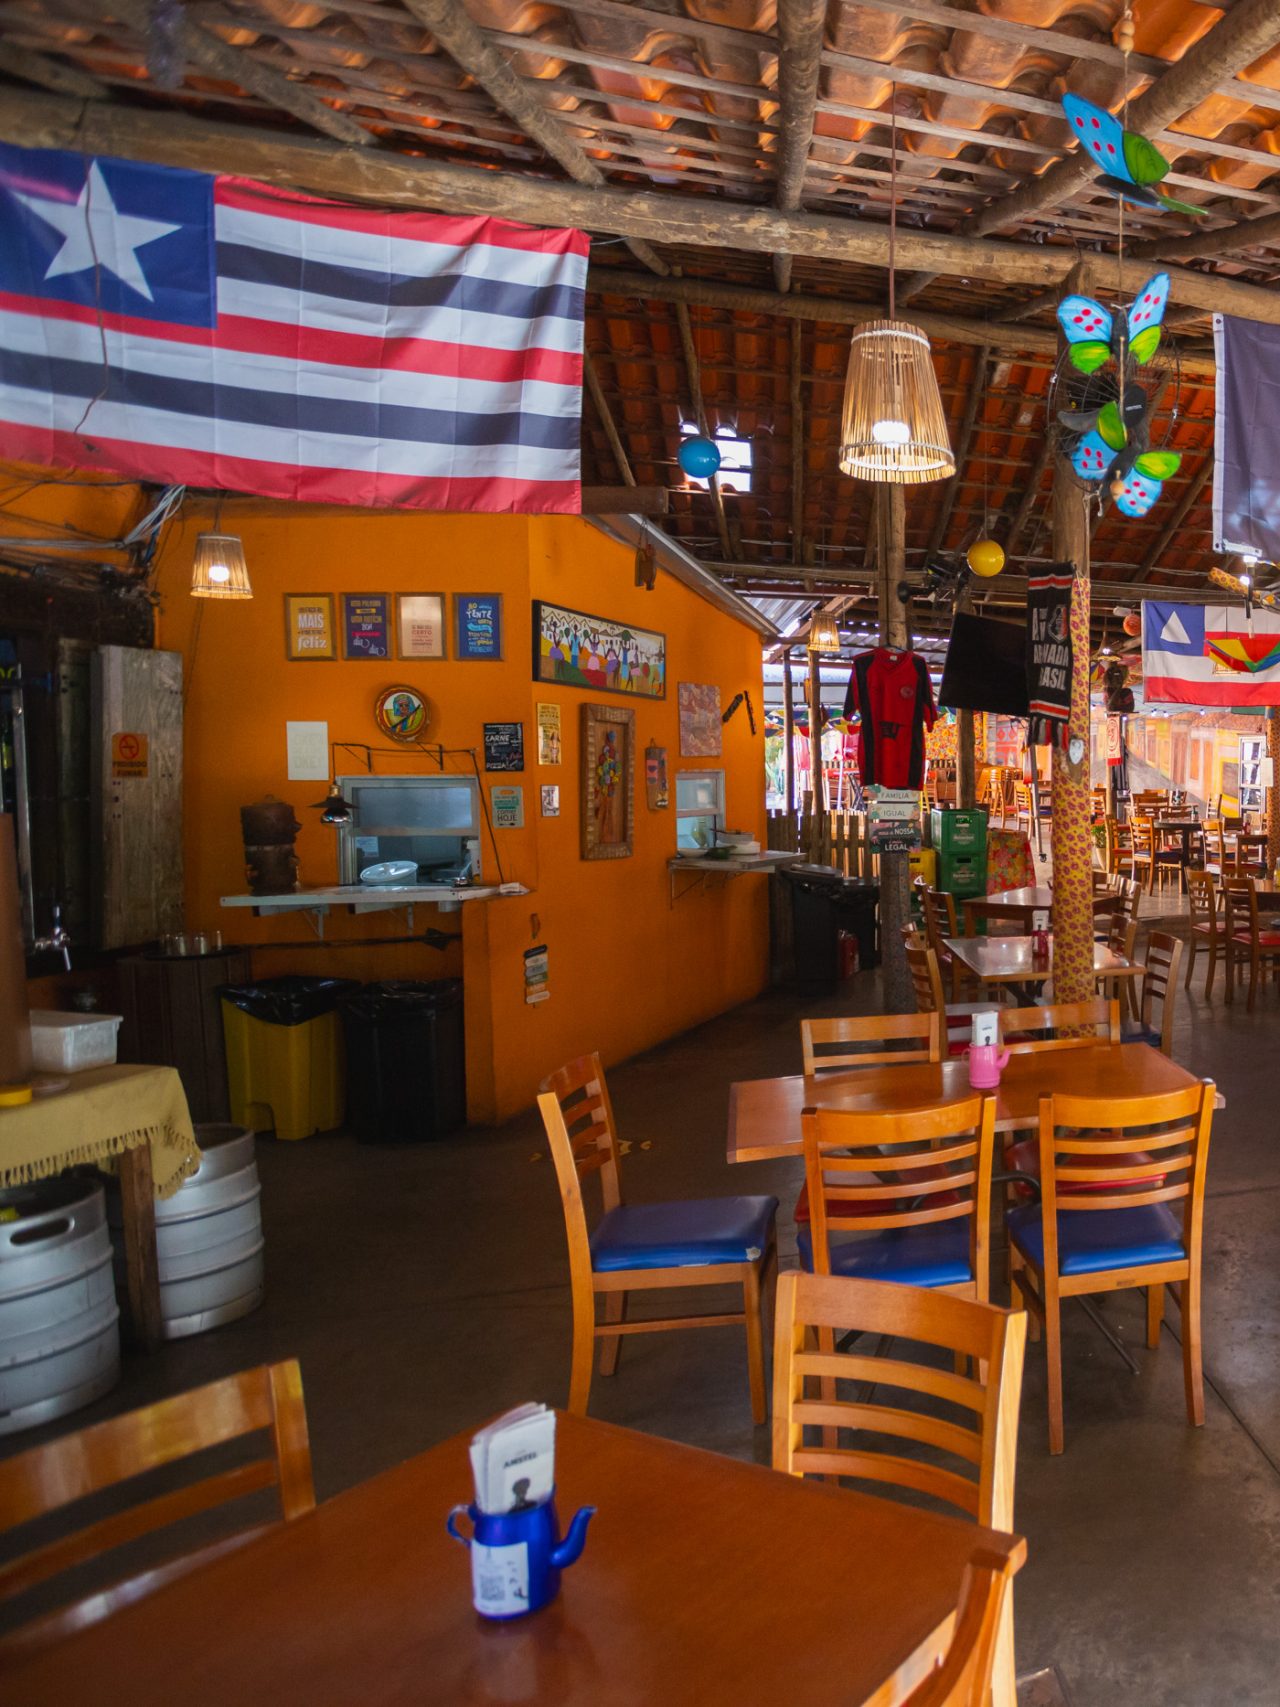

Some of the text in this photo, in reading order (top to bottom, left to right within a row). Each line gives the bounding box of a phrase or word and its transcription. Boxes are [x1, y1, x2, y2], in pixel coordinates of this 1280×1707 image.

[298, 613, 324, 629] MAIS
[497, 814, 518, 822] HOJE
[884, 843, 908, 851] LEGAL
[503, 1451, 538, 1469] AMSTEL
